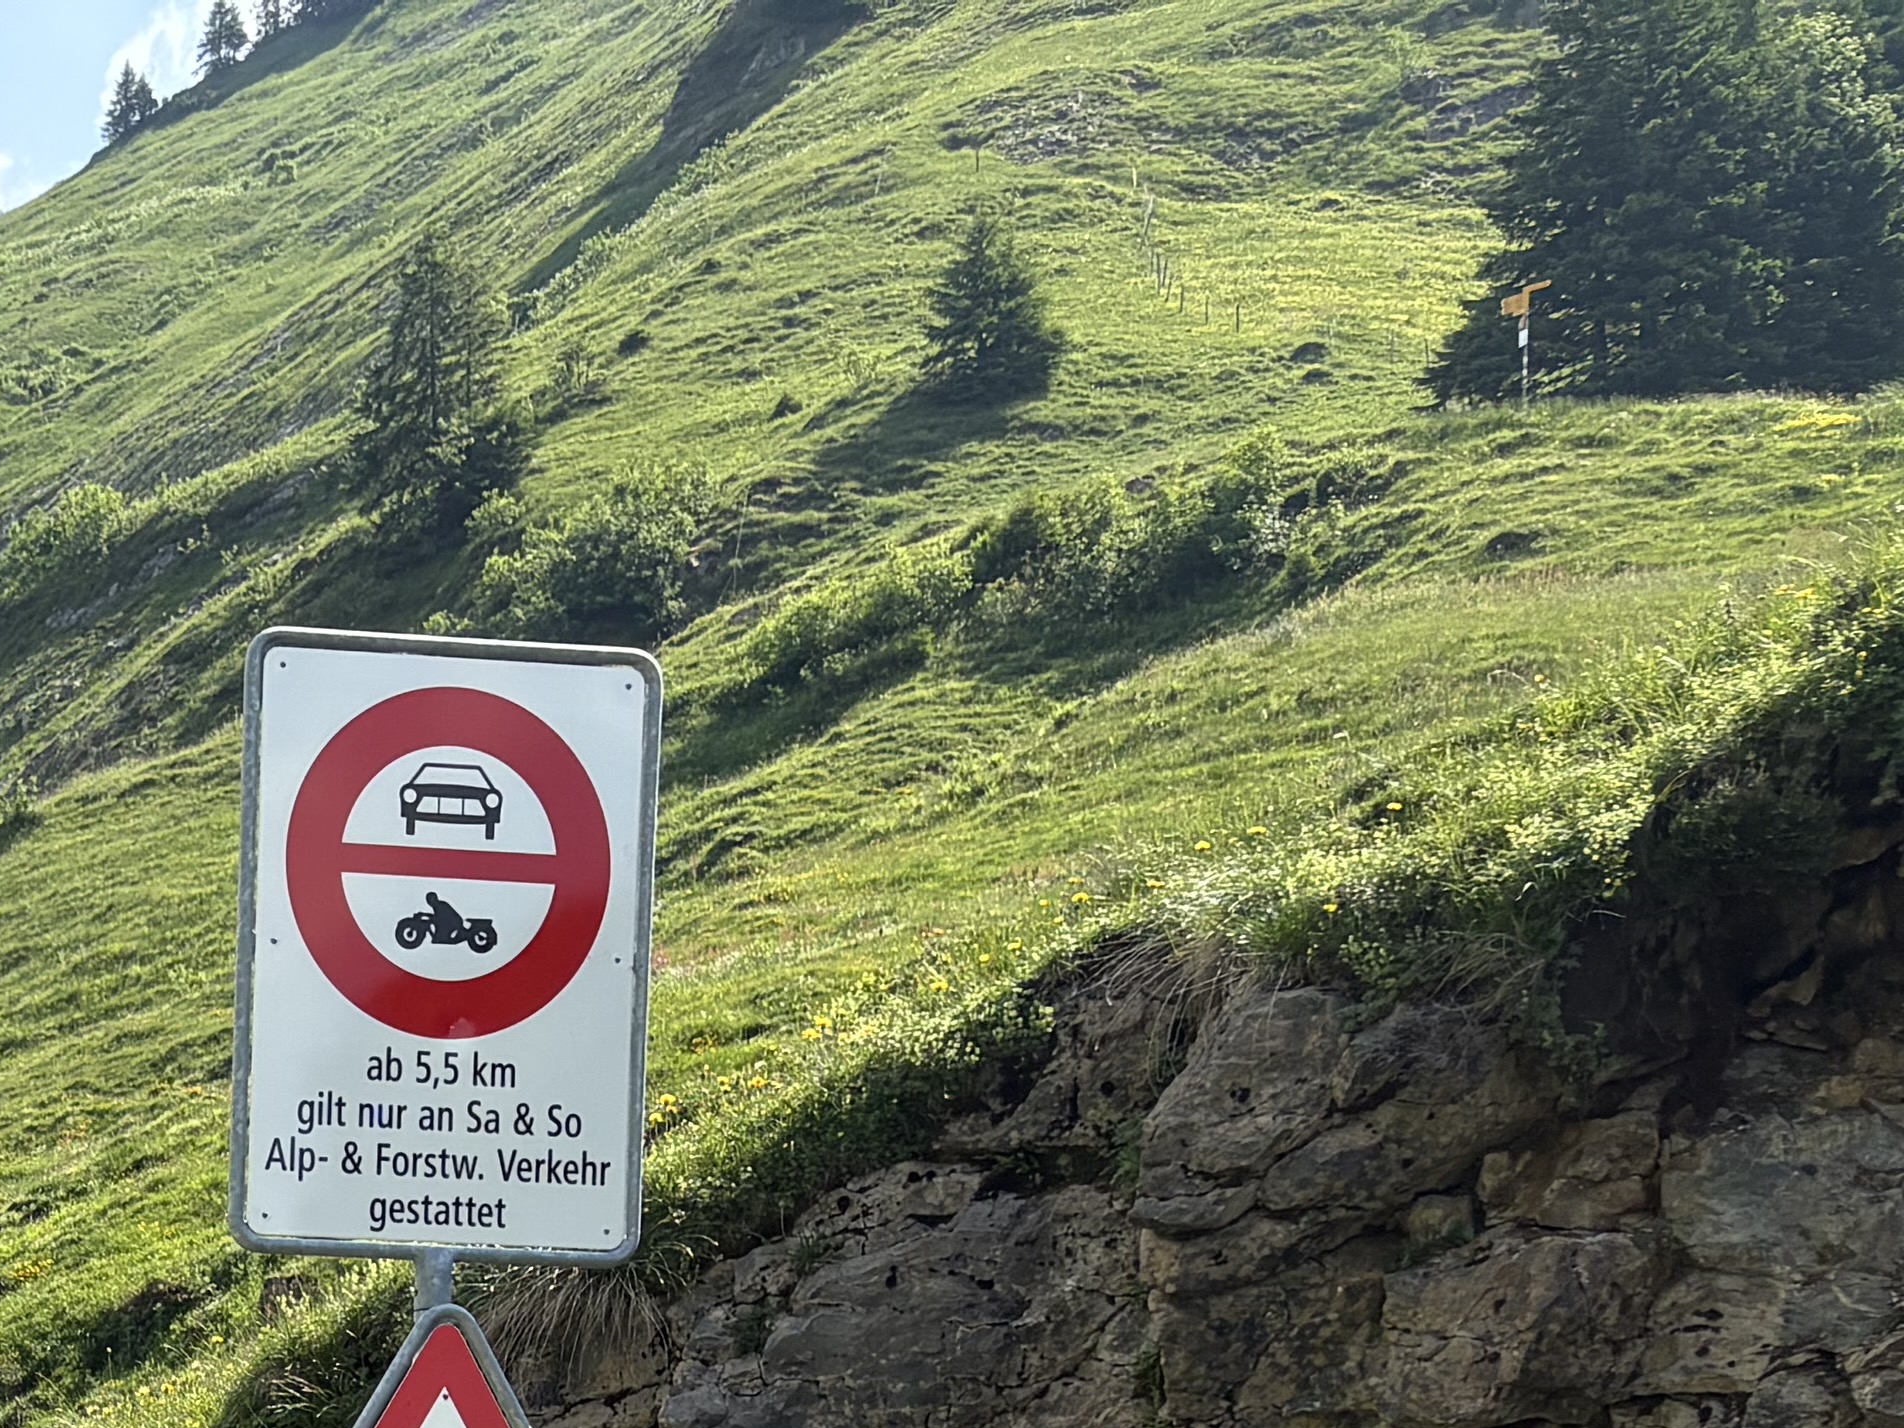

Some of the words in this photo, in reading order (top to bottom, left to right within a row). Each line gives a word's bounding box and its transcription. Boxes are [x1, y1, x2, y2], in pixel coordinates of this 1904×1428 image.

[366, 1046, 403, 1084] ab
[415, 1050, 460, 1090] 5,5
[472, 1050, 516, 1089] km
[297, 1090, 347, 1135] gilt
[358, 1102, 408, 1130] nur
[418, 1105, 454, 1133] an
[466, 1099, 500, 1135] Sa
[513, 1102, 535, 1137] &
[546, 1103, 582, 1139] So
[264, 1136, 329, 1182] Alp-
[341, 1140, 363, 1176] &
[376, 1142, 485, 1181] Forstw.
[496, 1148, 612, 1187] Verkehr
[369, 1194, 507, 1233] gestattet
